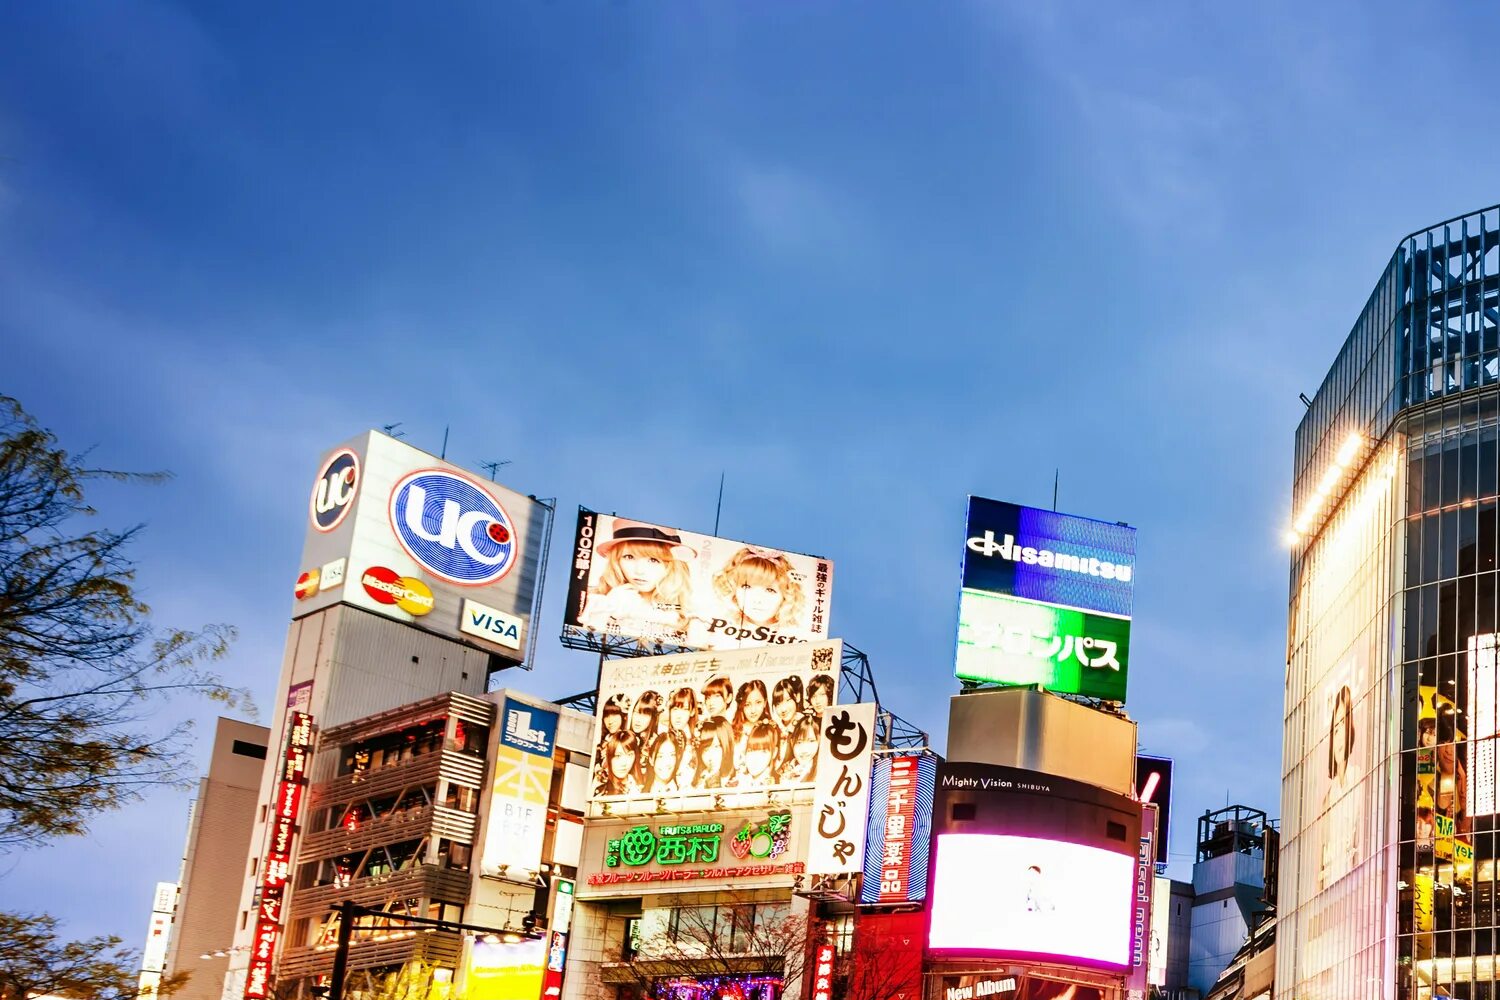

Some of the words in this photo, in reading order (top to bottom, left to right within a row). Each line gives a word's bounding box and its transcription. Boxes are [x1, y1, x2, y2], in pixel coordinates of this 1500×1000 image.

[966, 530, 1132, 582] Hisamitsu
[362, 573, 435, 608] MasterCard
[470, 610, 518, 641] VISA
[816, 710, 868, 866] もんじゃ
[942, 775, 978, 789] Mighty
[981, 777, 1012, 790] Vision
[1017, 782, 1051, 793] SHIBUYA
[880, 756, 917, 895] 三千里薬品
[656, 835, 720, 865] 西村
[976, 977, 1017, 997] Album
